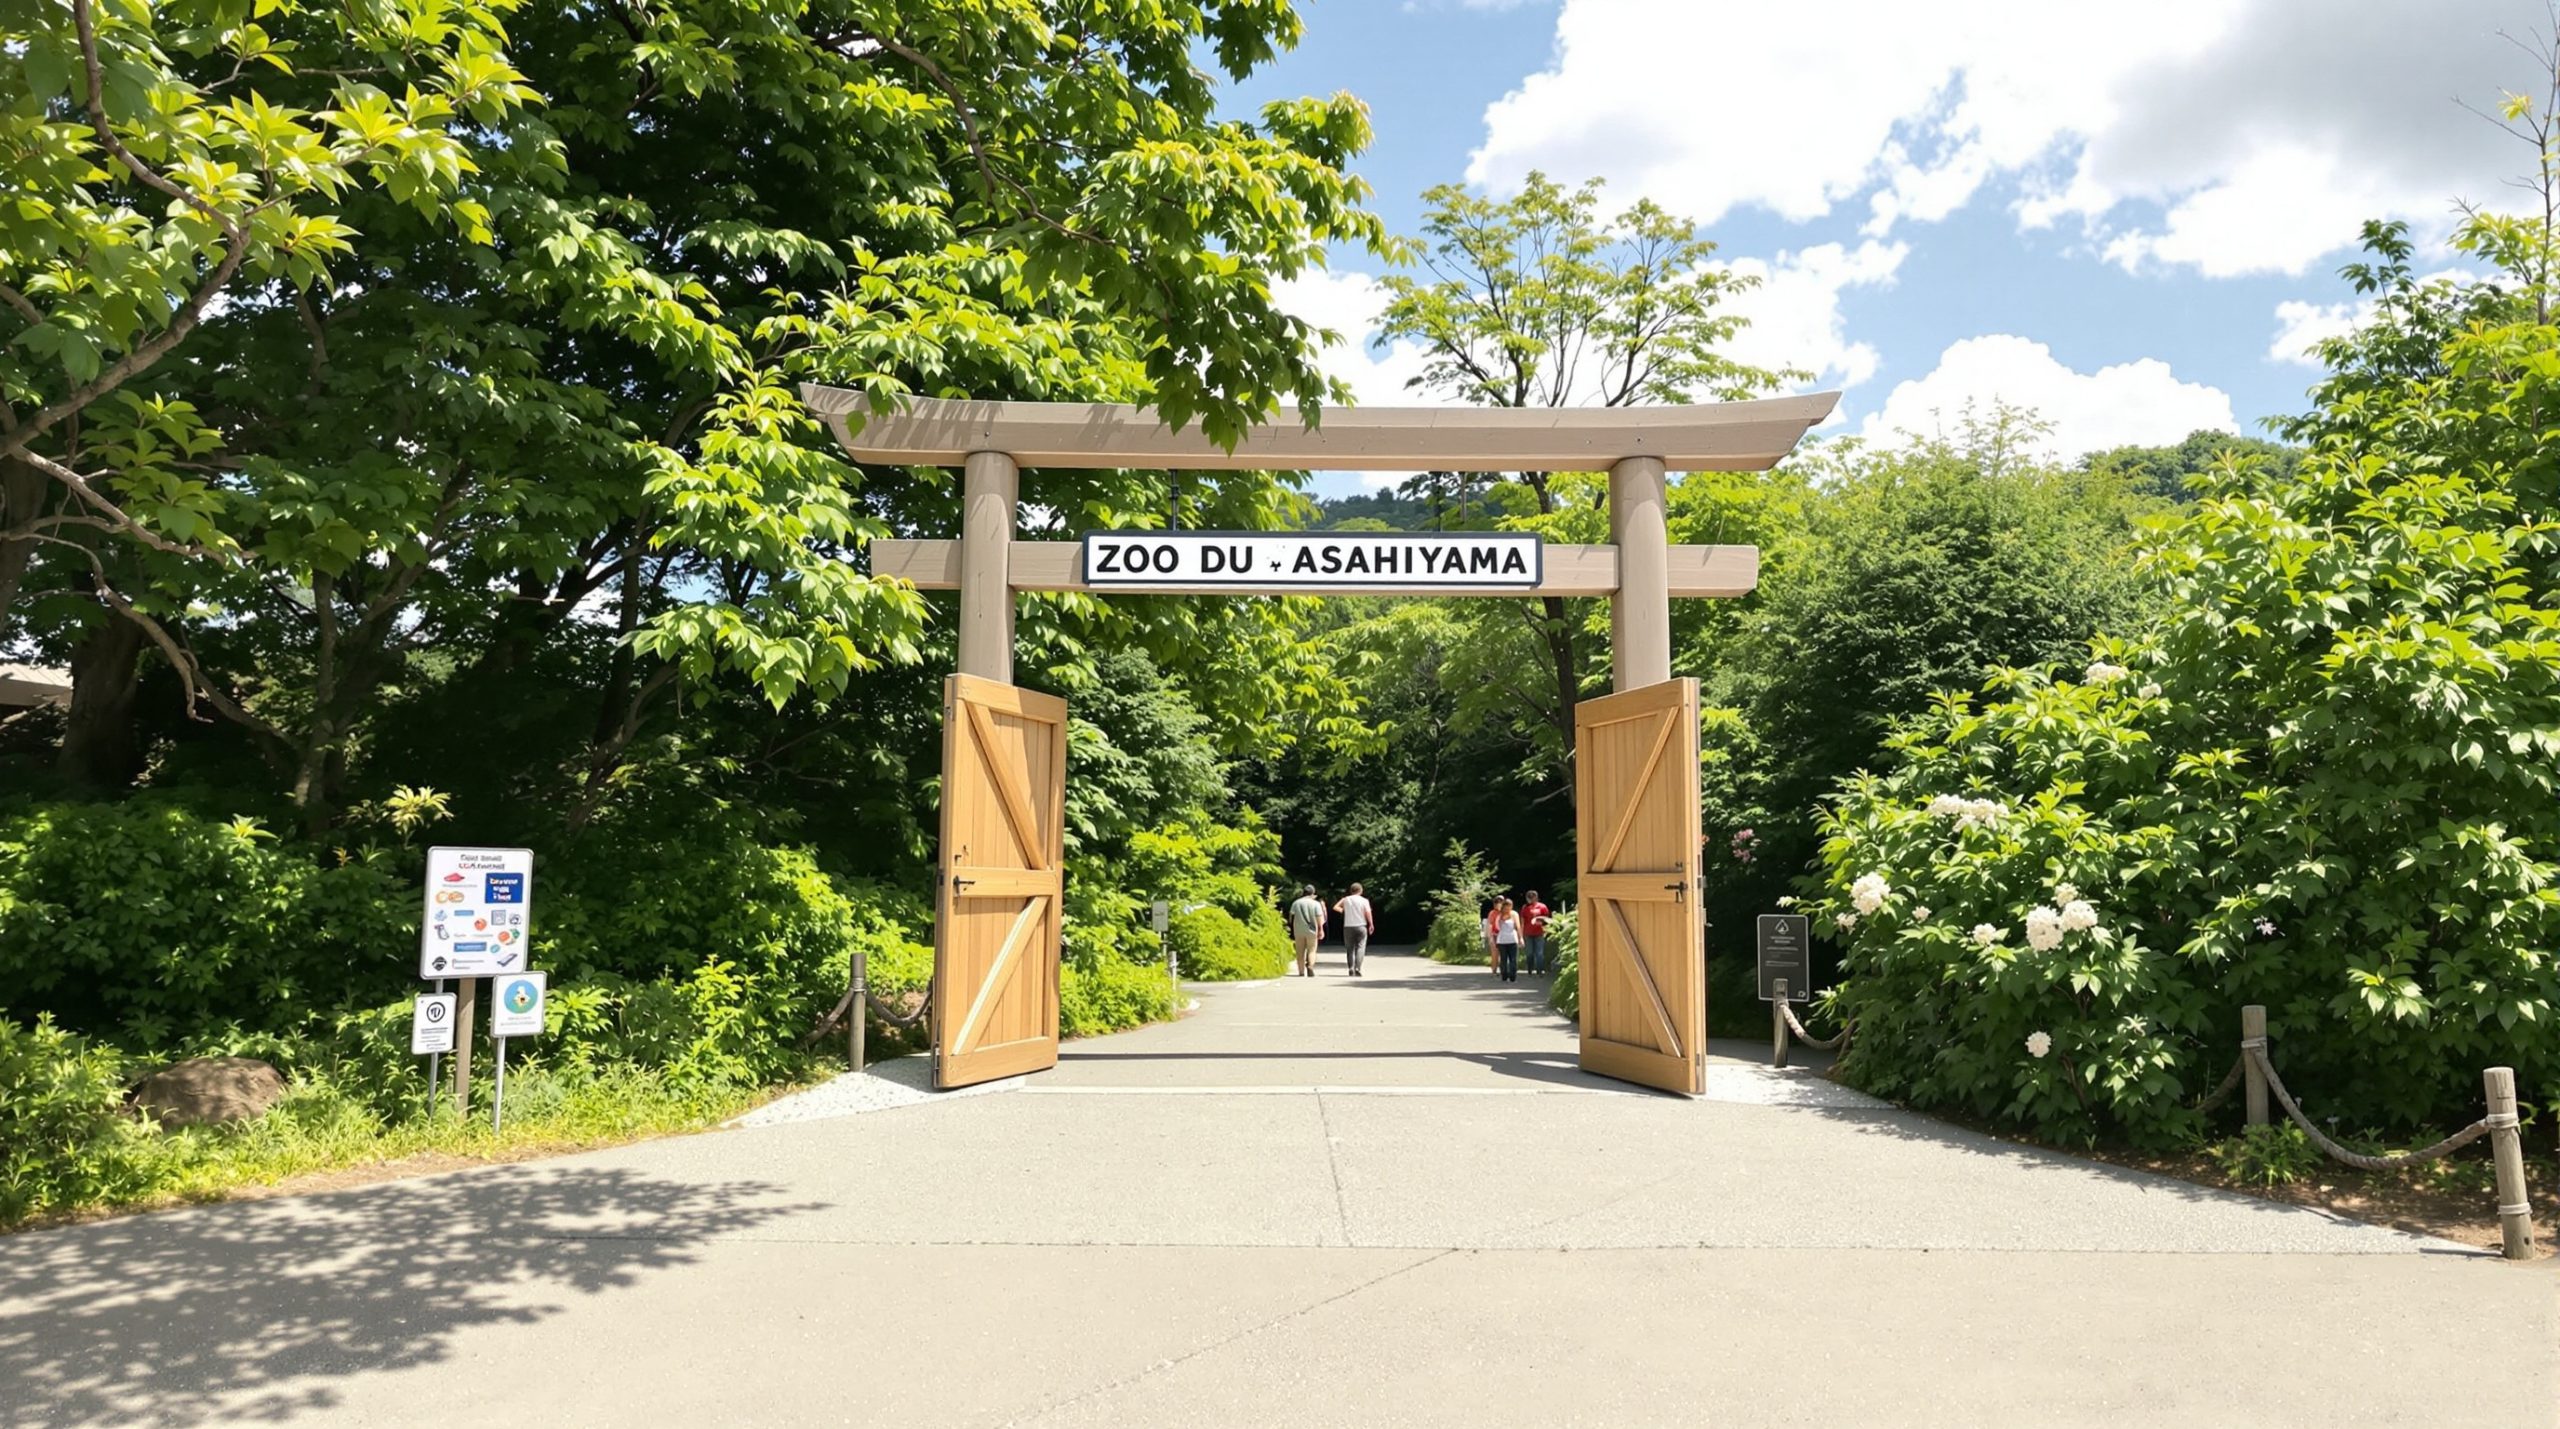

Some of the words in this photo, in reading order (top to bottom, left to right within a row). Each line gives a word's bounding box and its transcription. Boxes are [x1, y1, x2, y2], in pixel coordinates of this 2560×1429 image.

[1096, 544, 1179, 574] ZOO
[1201, 545, 1254, 574] DU
[1292, 545, 1527, 574] ASAHIYAMA
